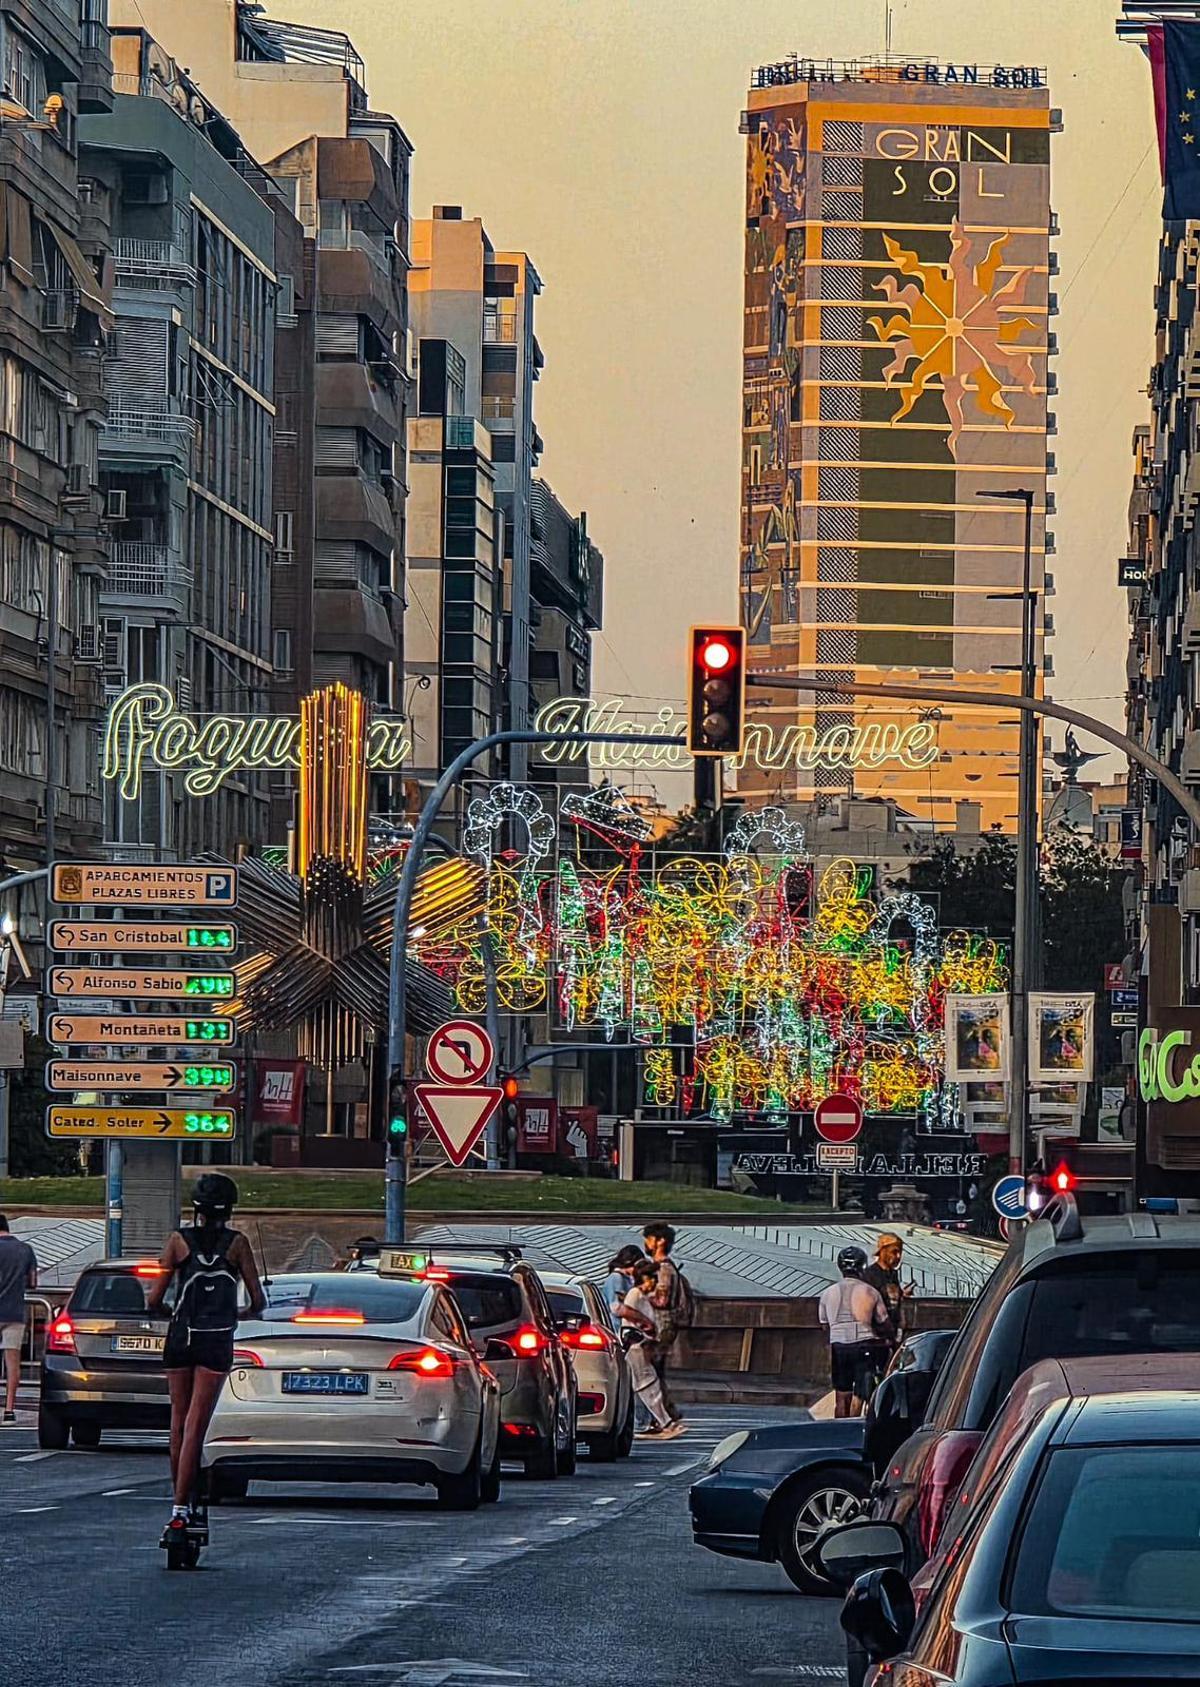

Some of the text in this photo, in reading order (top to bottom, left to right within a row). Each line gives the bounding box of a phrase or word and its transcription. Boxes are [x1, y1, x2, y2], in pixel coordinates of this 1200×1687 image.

[904, 64, 978, 84] GRAN
[875, 129, 1011, 164] GRAN
[892, 166, 1005, 198] SOL
[103, 683, 940, 800] Fogua Maisnnave
[86, 871, 203, 883] APARCAMIENTOS
[92, 887, 196, 899] PLAZAS LIBRES
[79, 930, 108, 942] San
[114, 930, 183, 943] Cristobal
[83, 976, 137, 989] Alfonso
[143, 977, 183, 990] Sabio
[100, 1022, 181, 1036] Montañeta
[53, 1070, 142, 1082] Maisonnave
[53, 1114, 230, 1132] Cated. Soler 364
